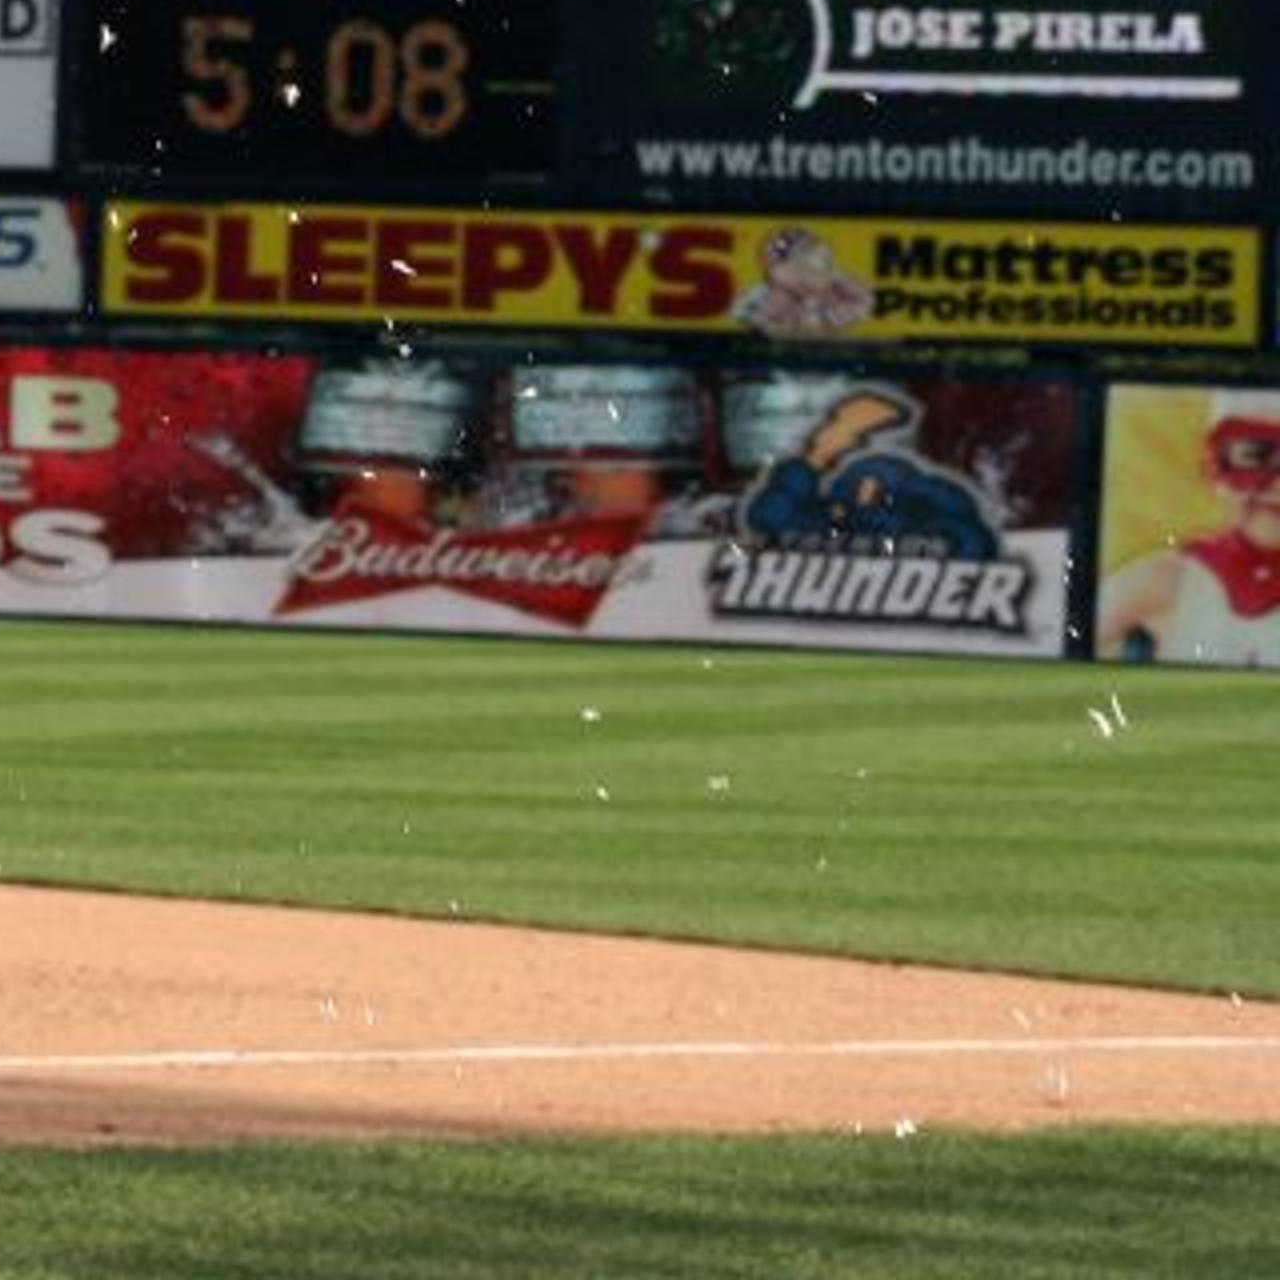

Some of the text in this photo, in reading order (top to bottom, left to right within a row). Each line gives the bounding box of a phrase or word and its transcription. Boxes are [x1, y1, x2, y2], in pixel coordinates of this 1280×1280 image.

[850, 7, 1206, 58] JOSE PIRELA
[637, 136, 1253, 187] www.trentonthunder.com
[872, 235, 1235, 287] Mattress
[872, 286, 1235, 329] Professionals
[288, 515, 652, 590] Budweiser
[707, 546, 1030, 627] THUNDER
